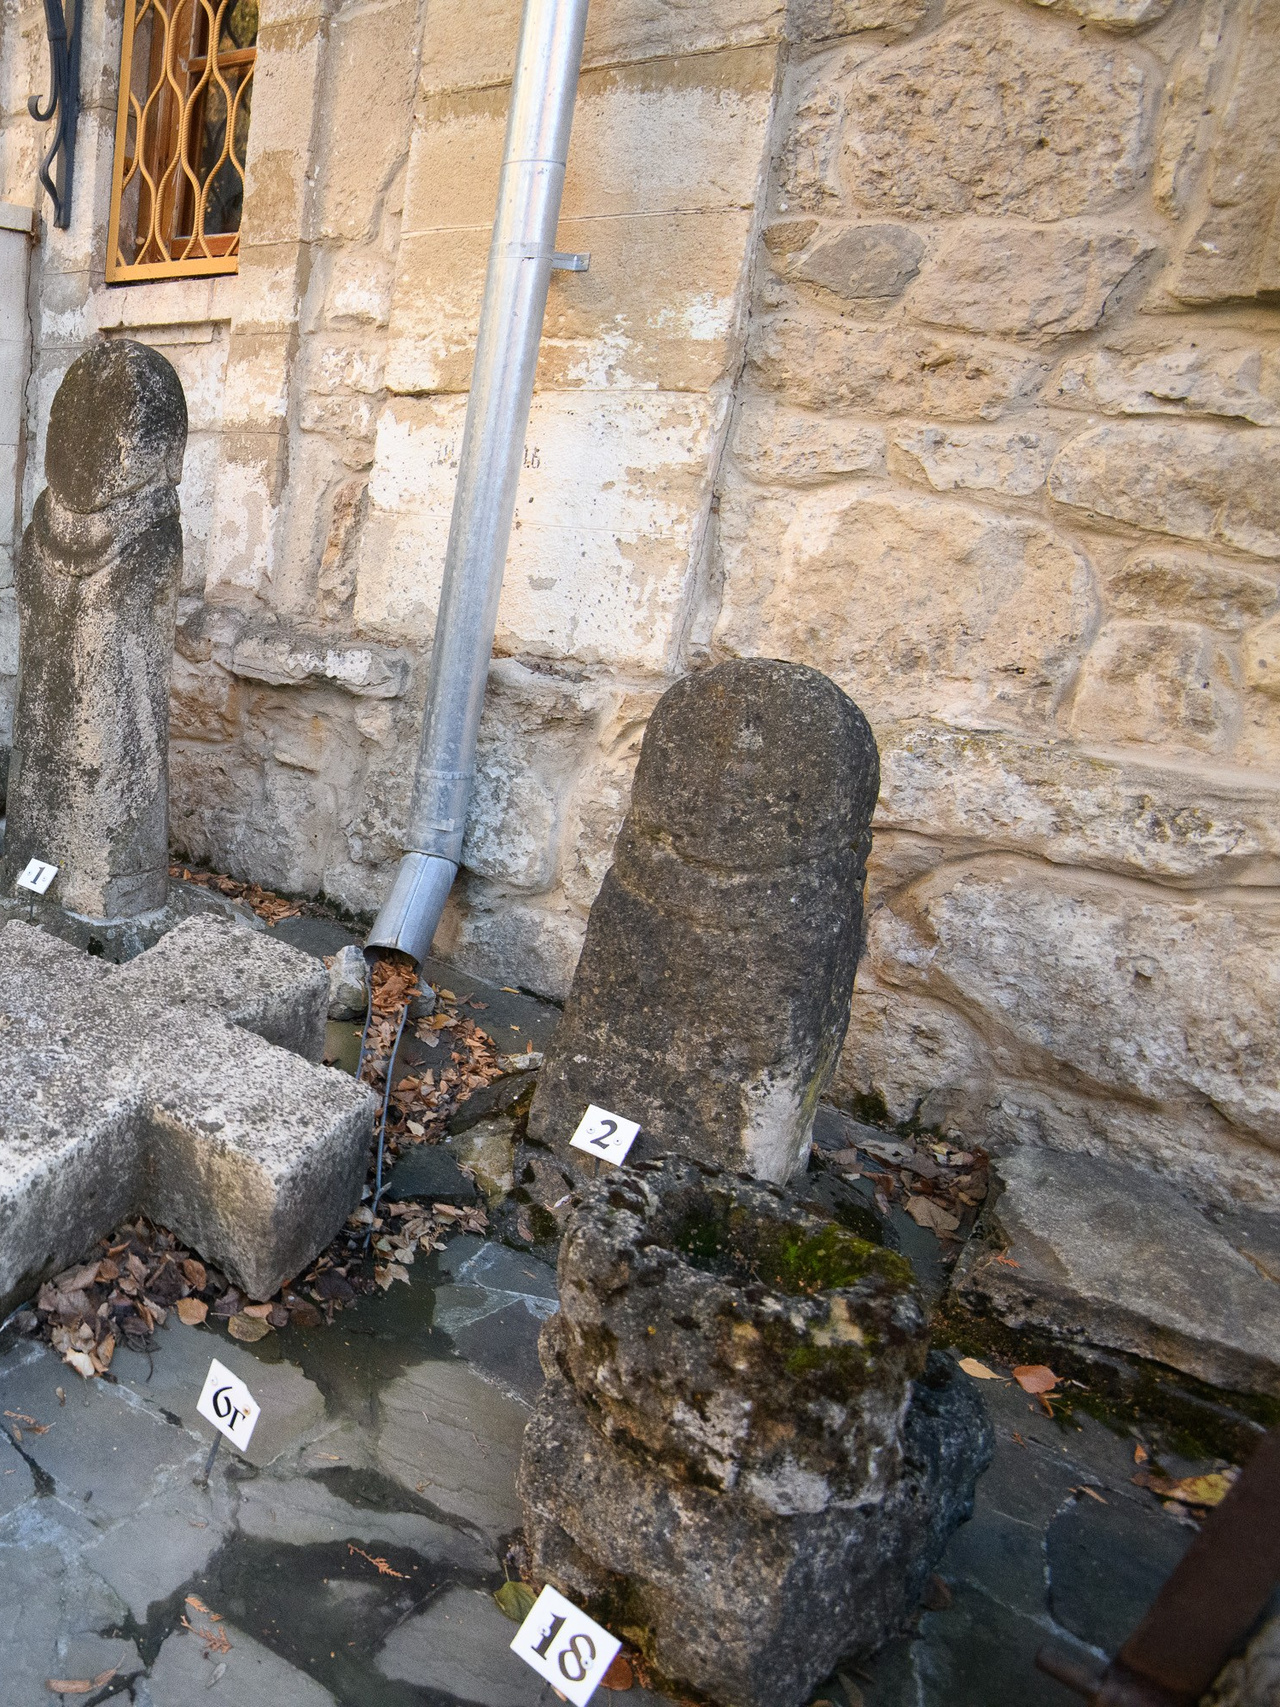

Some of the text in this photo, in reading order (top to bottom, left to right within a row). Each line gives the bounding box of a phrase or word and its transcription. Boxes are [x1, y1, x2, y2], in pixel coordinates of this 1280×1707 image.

[30, 866, 45, 885] 1
[589, 1119, 618, 1150] 2
[530, 1611, 596, 1682] 18
